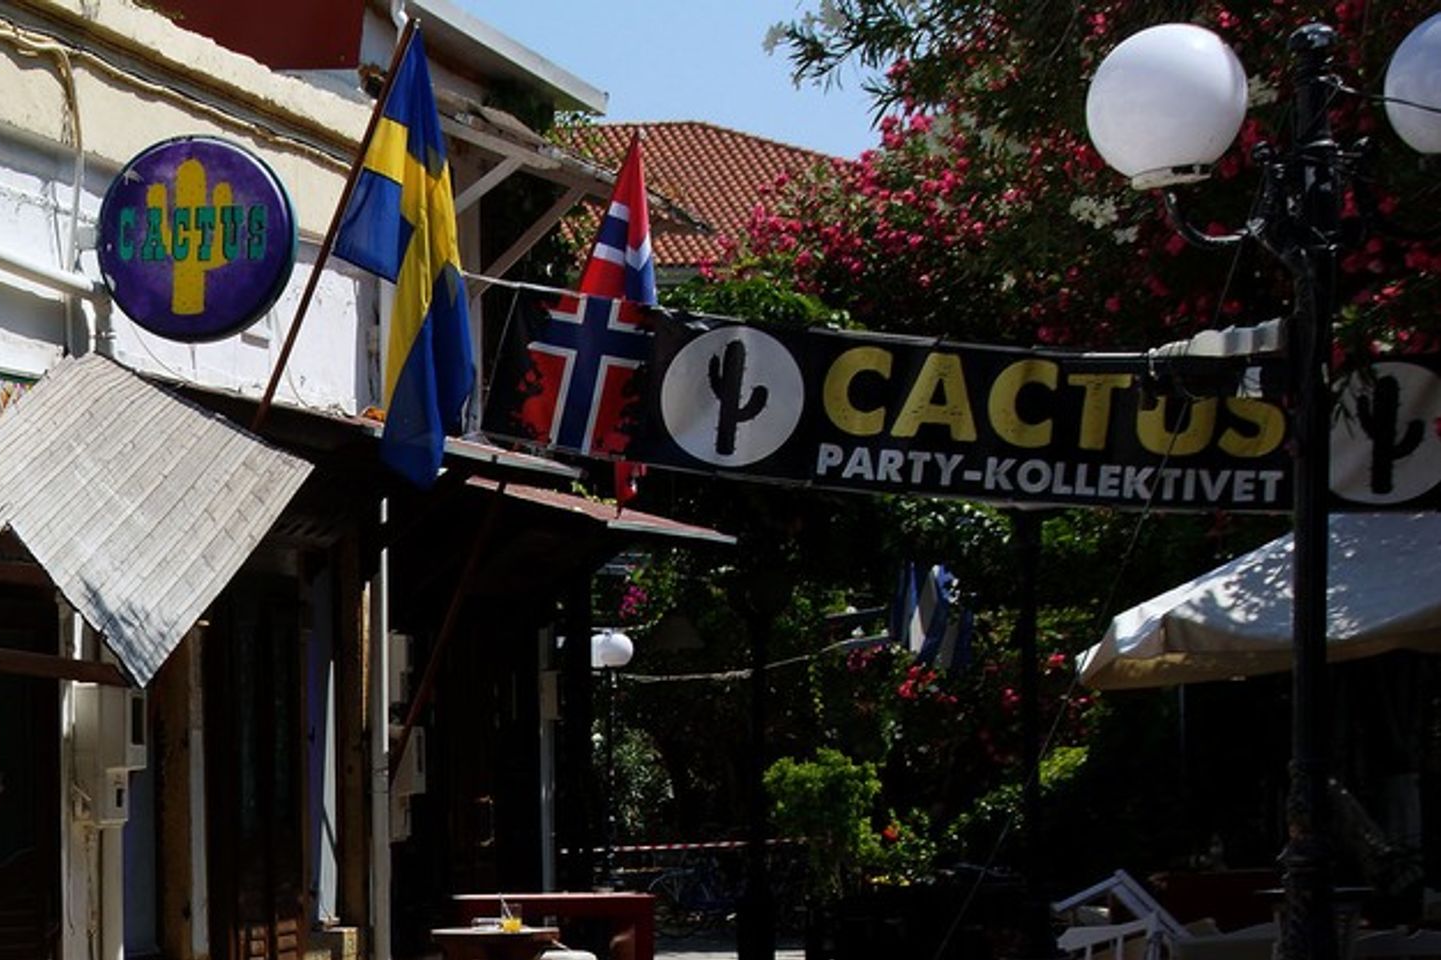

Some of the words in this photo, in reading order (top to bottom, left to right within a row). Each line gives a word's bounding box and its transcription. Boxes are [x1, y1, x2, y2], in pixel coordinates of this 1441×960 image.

[120, 205, 268, 261] CACTUS
[823, 346, 1286, 458] CACTUS
[816, 442, 1284, 503] PARTY-KOLLEKTIVET
